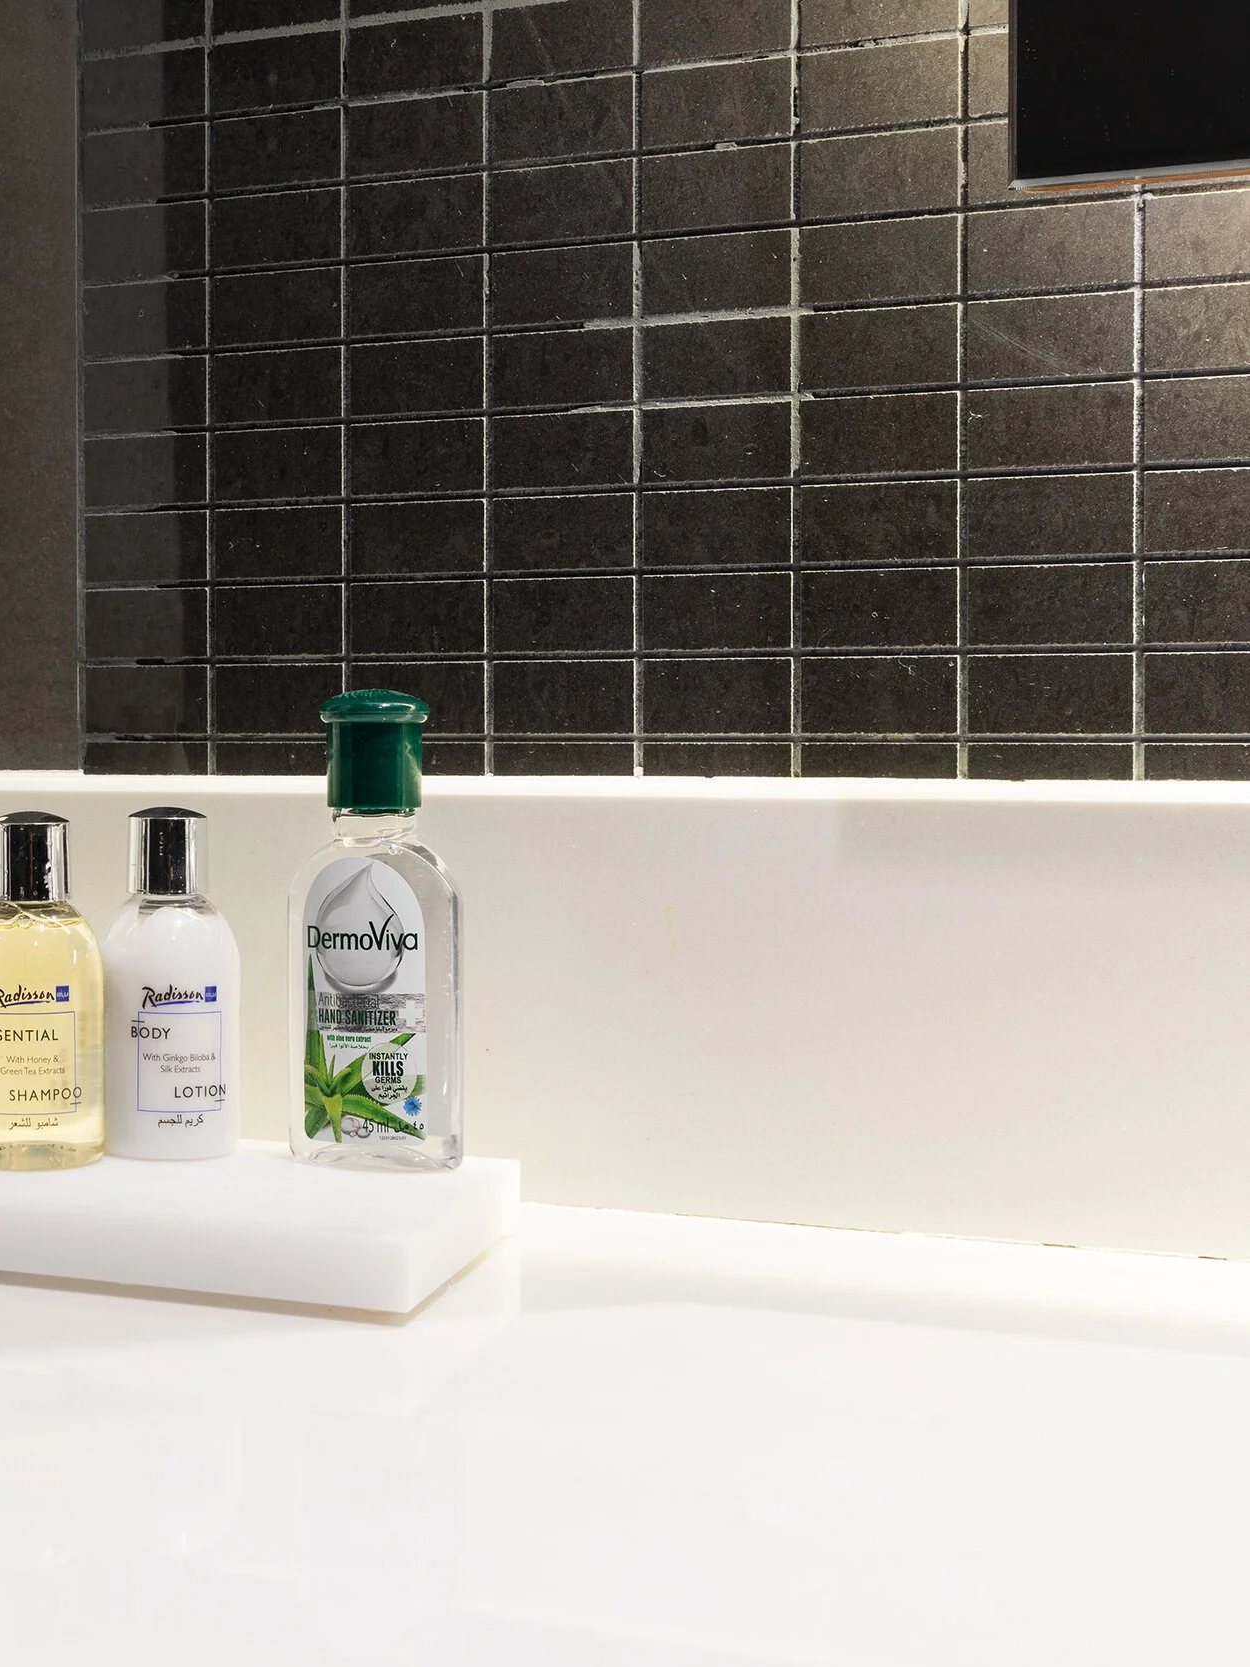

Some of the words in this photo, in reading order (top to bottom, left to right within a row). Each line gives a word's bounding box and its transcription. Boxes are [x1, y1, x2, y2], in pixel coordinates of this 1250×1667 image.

[307, 914, 418, 951] DermoViva
[142, 984, 204, 1009] Radisson
[318, 992, 380, 1009] Antibacterial
[318, 1008, 342, 1024] HAND
[344, 1009, 397, 1026] SANITIZER
[131, 1026, 171, 1039] BODY
[6, 1055, 24, 1064] With
[27, 1055, 51, 1065] Honey
[53, 1055, 59, 1063] &
[143, 1053, 161, 1062] With
[162, 1053, 188, 1064] Ginkgo
[190, 1053, 210, 1061] Biloba
[368, 1052, 408, 1061] INSTANTLY
[0, 1067, 23, 1075] Green
[24, 1067, 37, 1075] Tea
[39, 1066, 65, 1075] Extracts
[160, 1065, 172, 1073] Silk
[174, 1065, 201, 1073] Extracts
[372, 1061, 404, 1076] KILLS
[375, 1076, 402, 1084] GERMS
[9, 1087, 82, 1102] SHAMPOO
[174, 1084, 227, 1098] LOTION
[9, 1117, 32, 1130] للشعر
[36, 1117, 59, 1130] شامبو
[157, 1114, 183, 1128] للجسم
[185, 1114, 204, 1128] كريم
[363, 1118, 374, 1133] 45
[377, 1117, 389, 1133] ml
